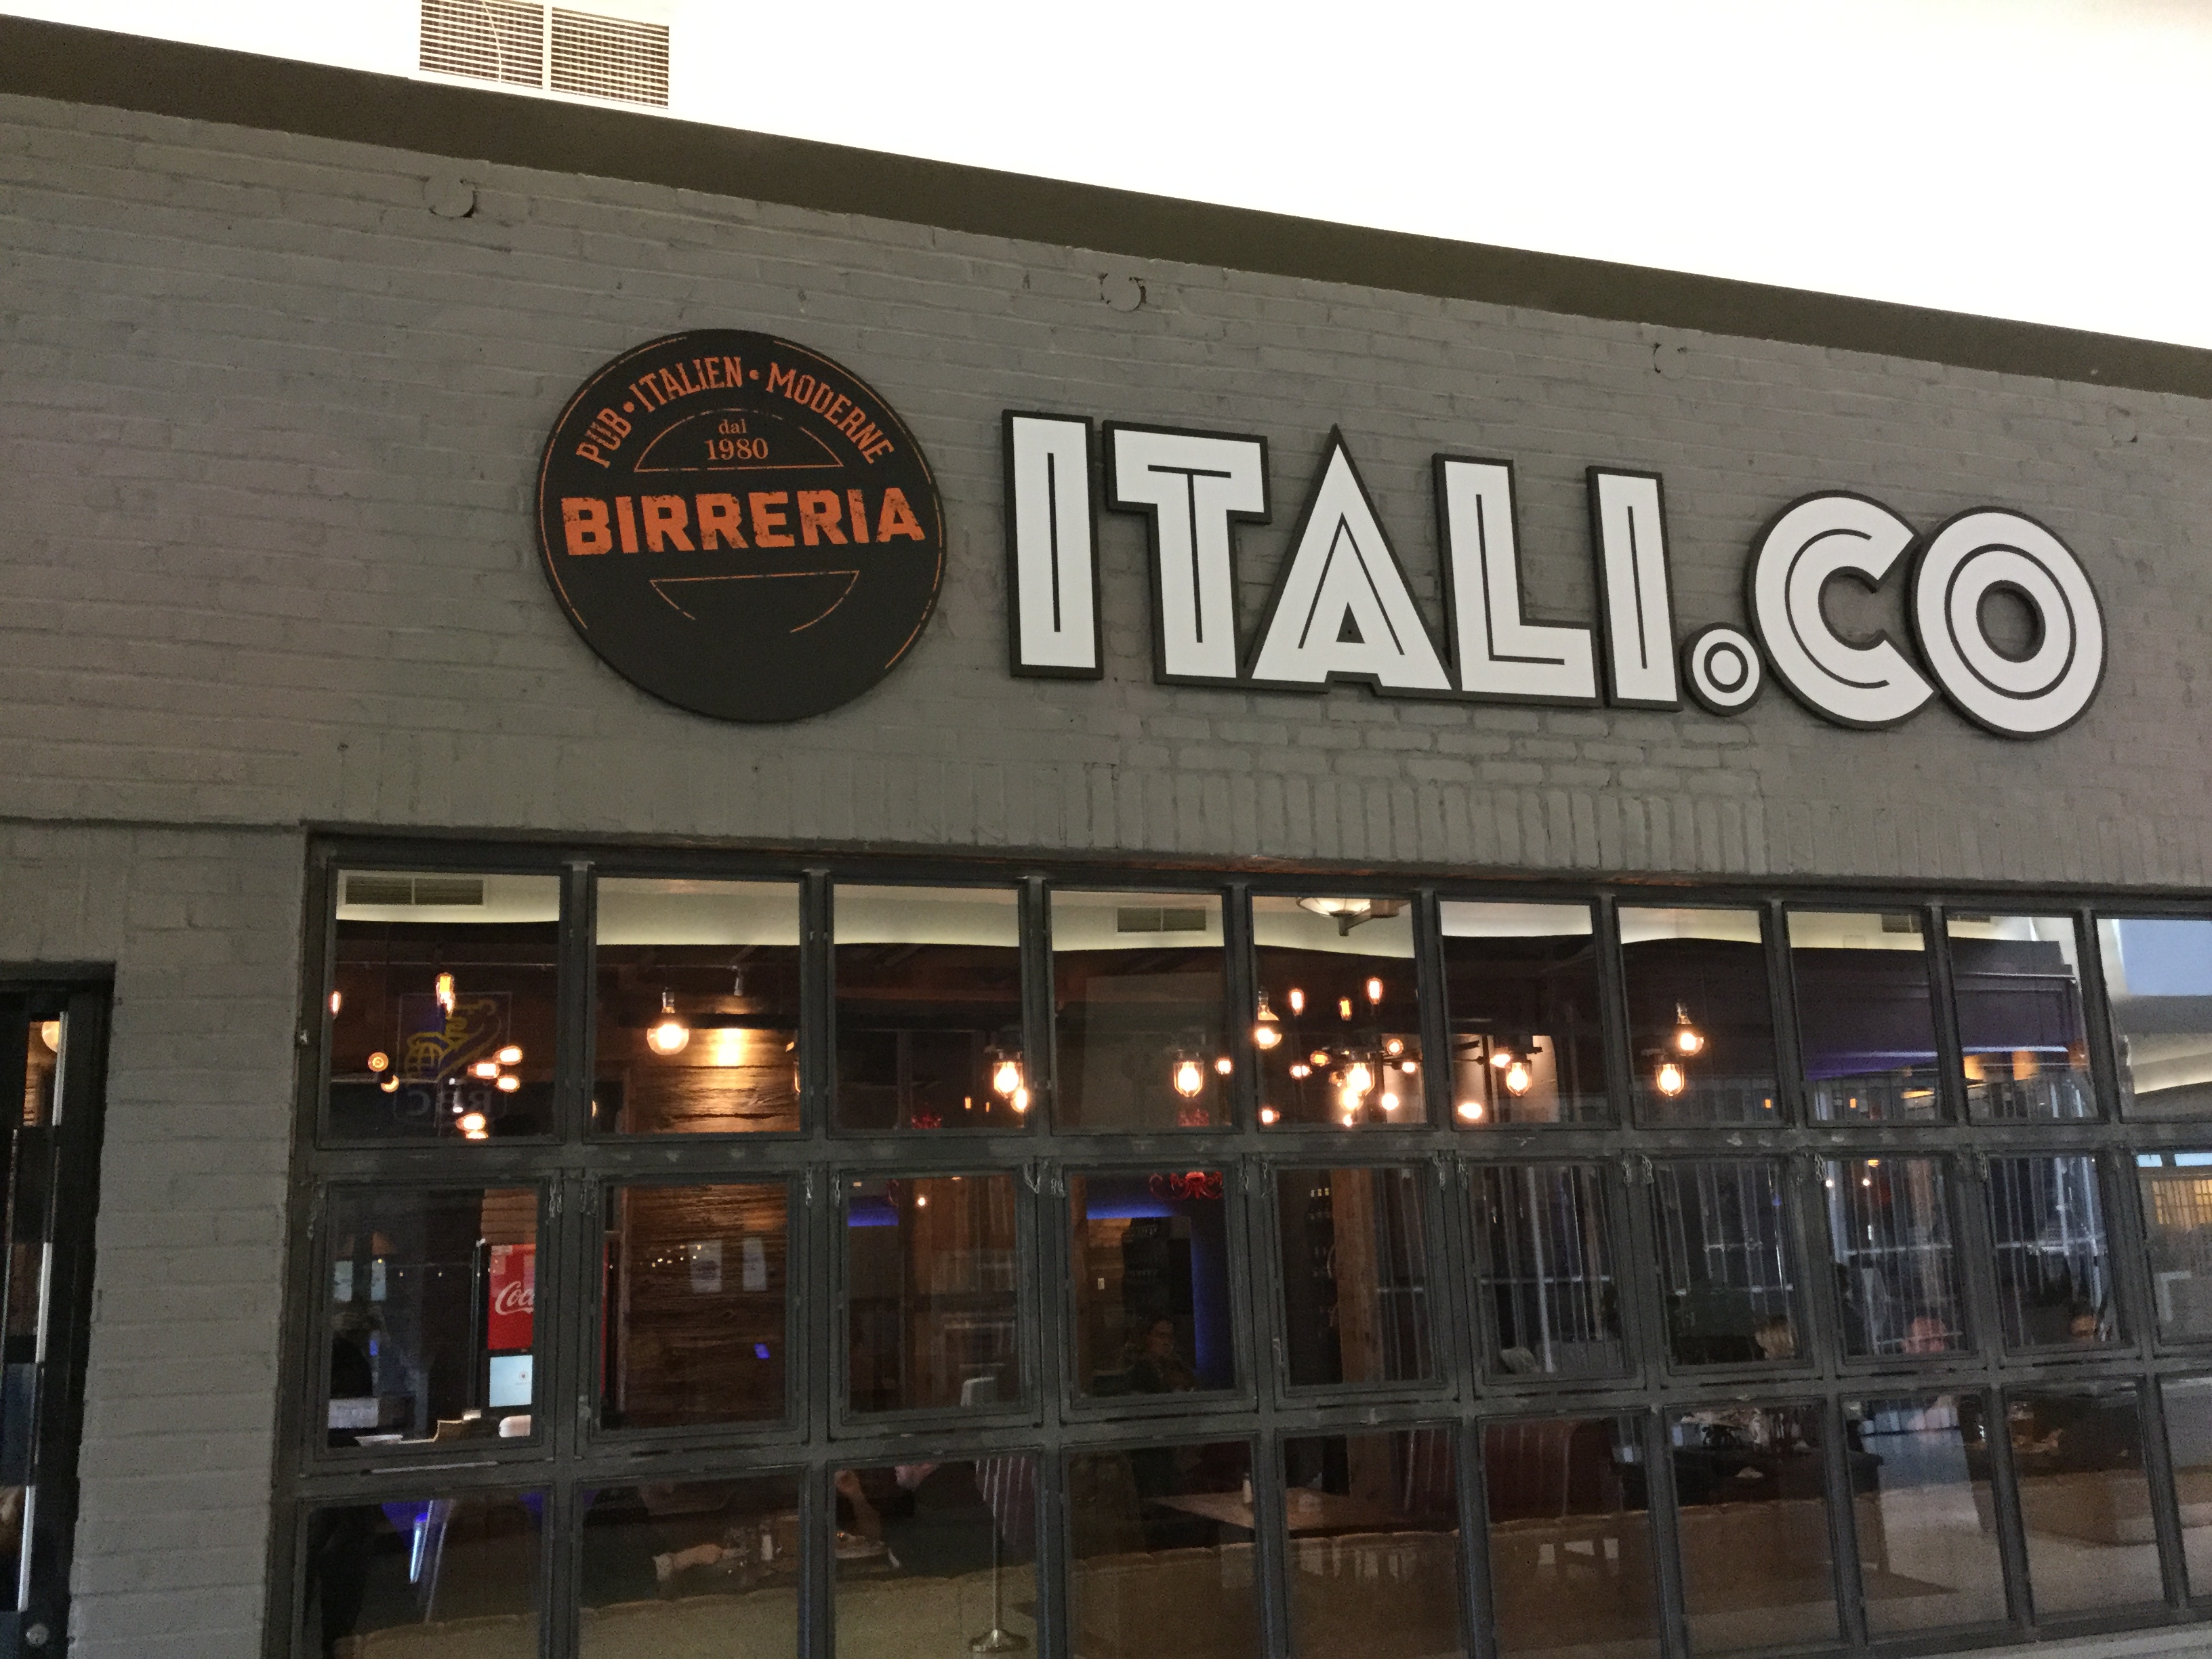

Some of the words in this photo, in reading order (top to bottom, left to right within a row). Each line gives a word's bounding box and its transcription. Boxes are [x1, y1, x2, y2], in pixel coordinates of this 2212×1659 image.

[576, 408, 632, 468] PUB
[630, 356, 743, 413] ITALIEN
[765, 362, 895, 464] MODERNE
[718, 418, 747, 434] dal
[704, 438, 769, 460] 1980
[561, 487, 925, 556] BIRRERIA
[1007, 412, 2105, 737] ITALI.CO
